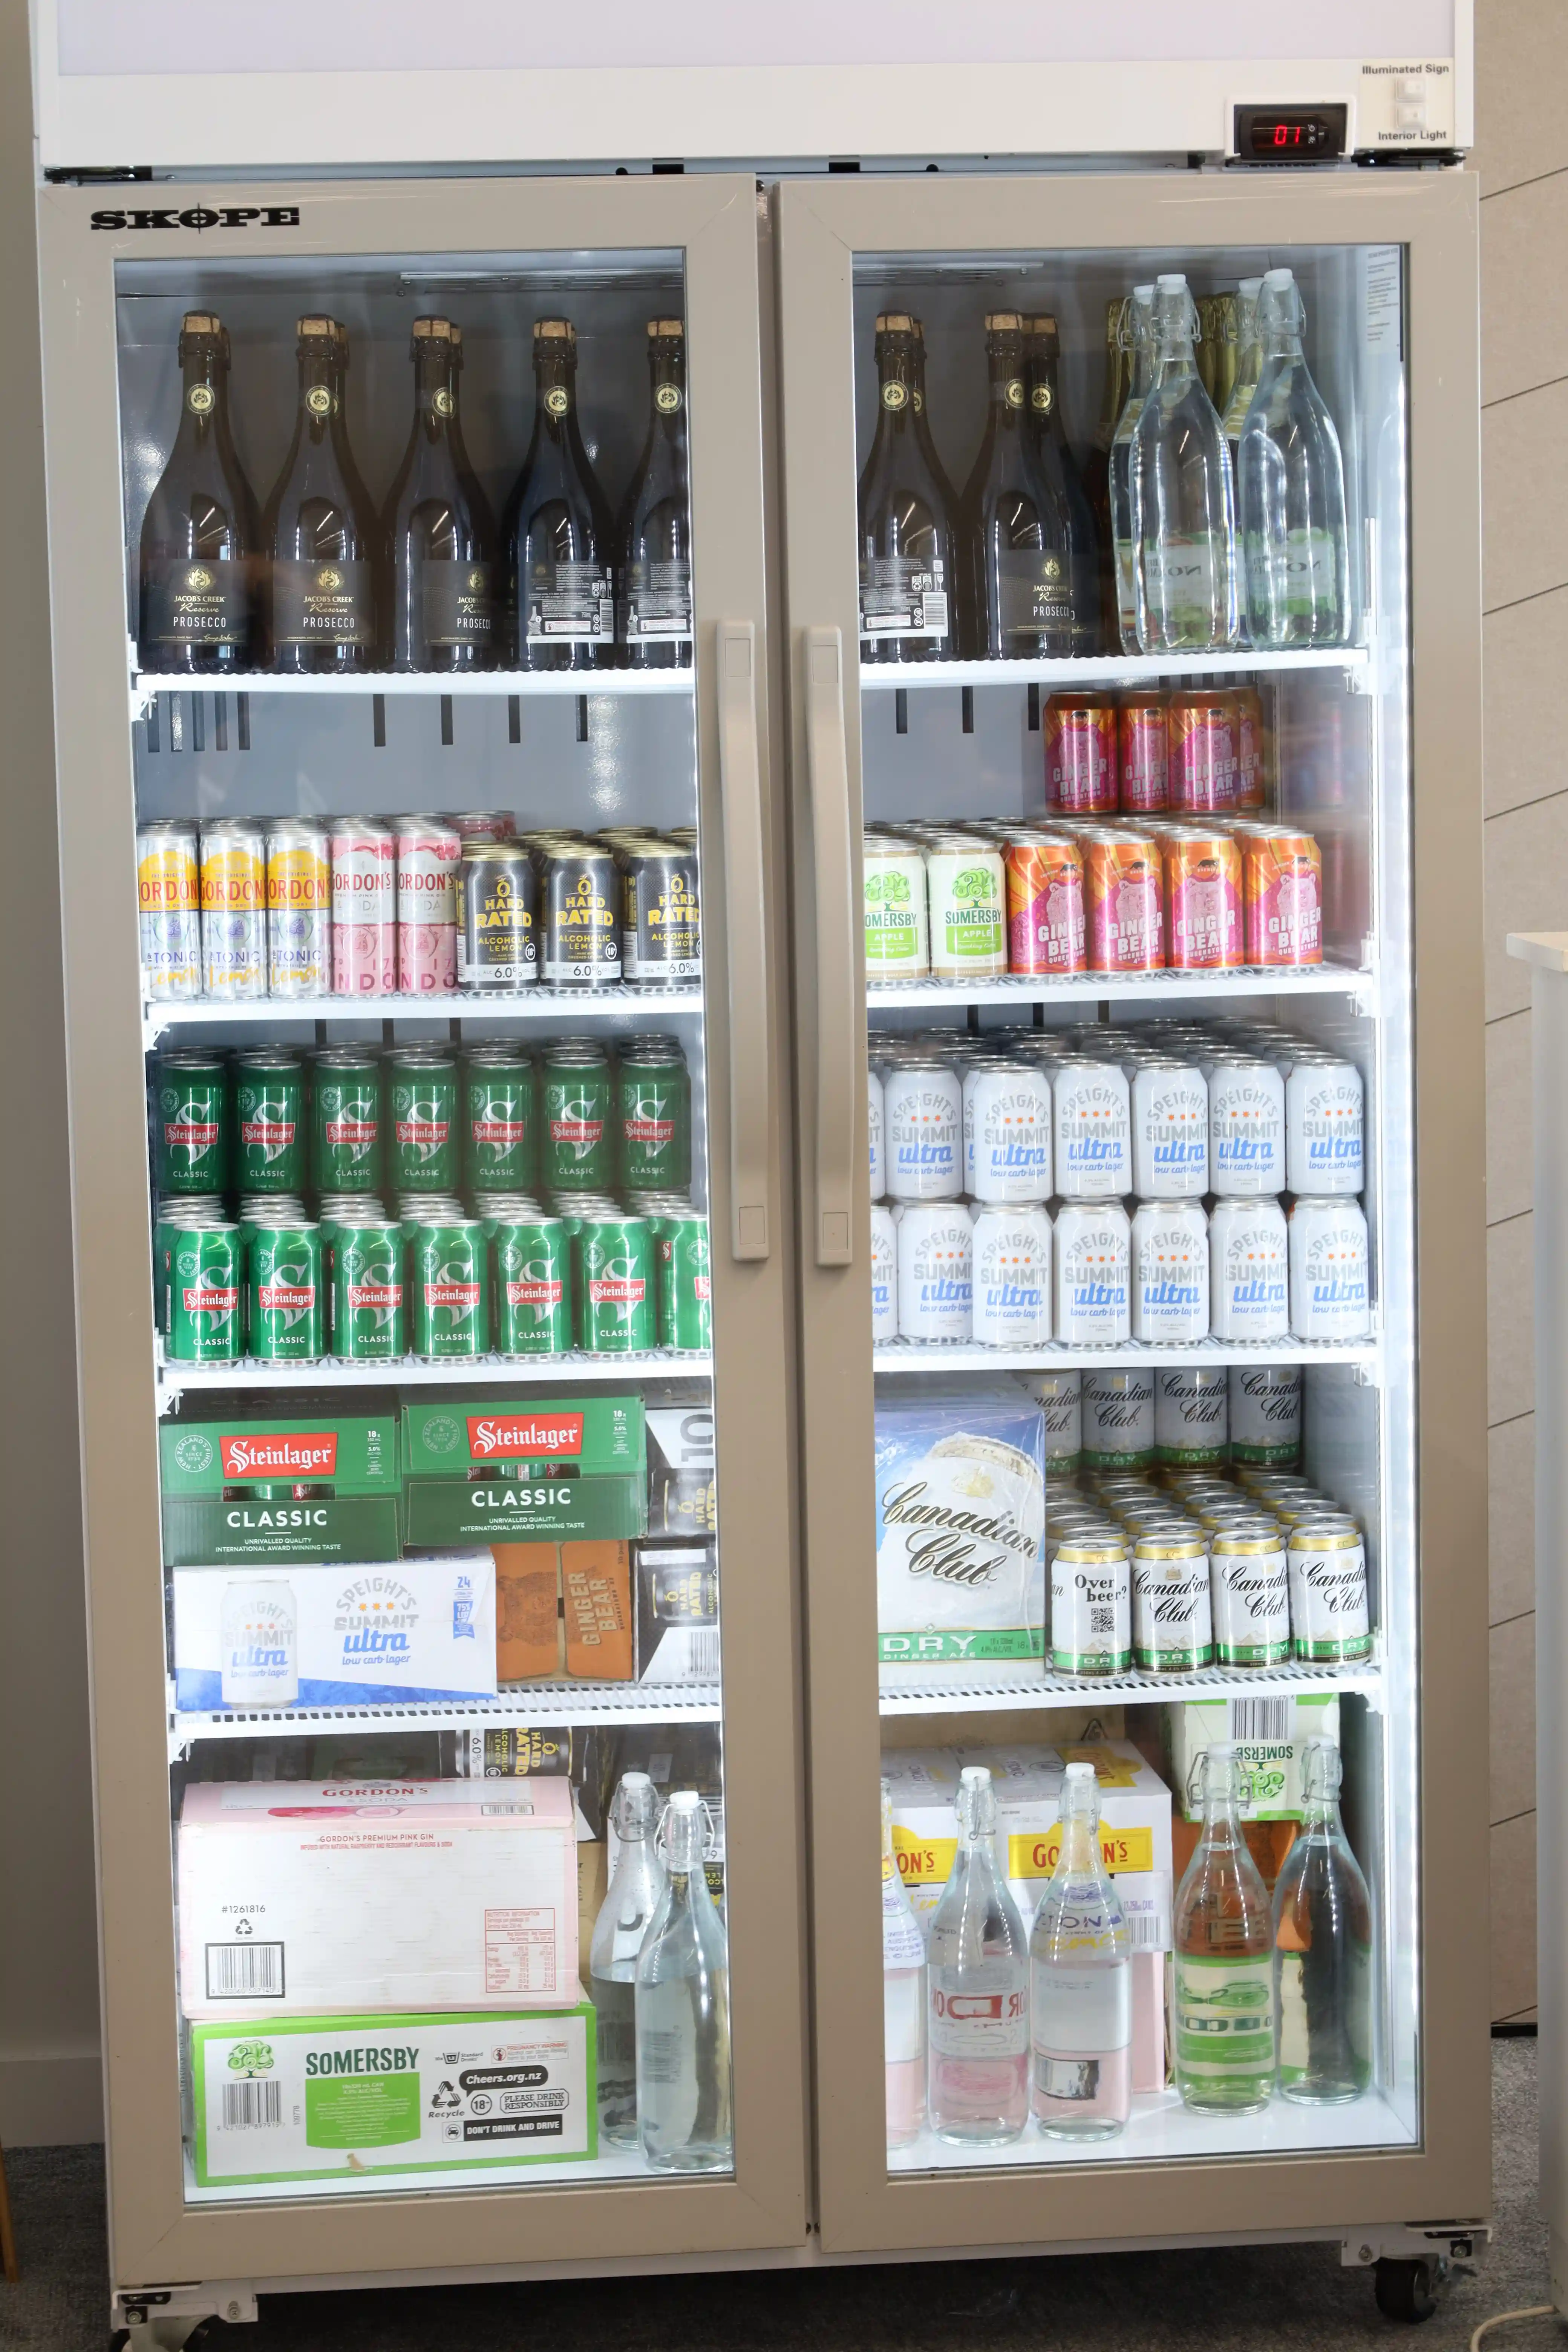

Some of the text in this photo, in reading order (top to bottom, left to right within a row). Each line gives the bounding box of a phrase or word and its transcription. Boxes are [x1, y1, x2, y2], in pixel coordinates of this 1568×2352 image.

[1362, 64, 1449, 76] Illuminated Sign
[1274, 125, 1300, 145] 01
[1378, 131, 1447, 142] Interior Light
[90, 203, 300, 234] SKOPE
[179, 603, 219, 613] Reserve
[309, 603, 348, 613] Reserve
[173, 616, 226, 628] PROSECCO
[303, 617, 355, 628] PROSECCO
[1053, 758, 1107, 782] GINGER
[1060, 775, 1101, 795] BEAR
[485, 898, 524, 910] HARD
[565, 897, 605, 908] HARD
[659, 895, 695, 906] HARD
[475, 911, 532, 930] RATED
[555, 910, 614, 927] RATED
[648, 908, 700, 926] RATED
[945, 909, 1001, 924] SOMERSBY
[1109, 911, 1163, 940] GINGER
[1269, 906, 1321, 934] GINGER
[478, 935, 530, 945] ALCOHOLIC
[489, 943, 522, 952] LEMON
[1118, 931, 1159, 955] BEAR
[216, 951, 260, 963] TONIC
[277, 950, 321, 961] TONIC
[495, 967, 522, 978] 6.0%
[573, 965, 602, 976] 6.0%
[668, 963, 695, 974] 6.0%
[893, 1093, 957, 1122] SPEIGHT'S
[985, 1095, 1049, 1124] SPEIGHT'S
[1062, 1087, 1125, 1118] SPEIGHT'S
[167, 1124, 216, 1141] Steinlager
[330, 1123, 377, 1141] Steinlager
[625, 1122, 672, 1139] Steinlager
[892, 1124, 957, 1142] SUMMIT
[985, 1125, 1050, 1145] SUMMIT
[1061, 1121, 1127, 1139] SUMMIT
[898, 1143, 954, 1164] ultra
[991, 1144, 1046, 1166] ultra
[1067, 1138, 1123, 1160] ultra
[630, 1166, 665, 1174] CLASSIC
[991, 1168, 1046, 1178] low carb lager
[982, 1233, 1047, 1263] SPEIGHT'S
[980, 1267, 1048, 1285] SUMMIT
[185, 1291, 237, 1309] Steinlager
[351, 1289, 401, 1306] Steinlager
[511, 1285, 561, 1302] Steinlager
[593, 1283, 644, 1300] Steinlager
[986, 1283, 1043, 1307] ultra
[193, 1338, 230, 1346] CLASSIC
[358, 1335, 395, 1343] CLASSIC
[1083, 1377, 1153, 1402] Canadian
[1095, 1403, 1139, 1427] Club
[1180, 1399, 1222, 1423] Club
[474, 1421, 578, 1453] Steinlager
[177, 1437, 211, 1470] NEW ZEALAND'S FINEST
[227, 1441, 332, 1473] Steinlager
[1184, 1450, 1220, 1458] DRY
[471, 1488, 571, 1507] CLASSIC
[695, 1488, 706, 1524] HARD
[227, 1510, 328, 1528] CLASSIC
[882, 1481, 1038, 1559] Canadian
[618, 1556, 623, 1564] 10
[905, 1528, 1007, 1585] Club
[457, 1577, 471, 1588] 24
[1075, 1574, 1115, 1589] Over
[1133, 1568, 1209, 1596] Canadian
[335, 1577, 417, 1613] SPEIGHT'S
[689, 1572, 703, 1616] RATED
[1086, 1587, 1127, 1602] beer?
[1323, 1588, 1363, 1613] Club
[568, 1571, 601, 1645] GINGER
[588, 1579, 617, 1631] BEAR
[1150, 1597, 1196, 1623] Club
[1245, 1592, 1285, 1618] Club
[334, 1614, 419, 1631] SUMMIT
[343, 1628, 411, 1653] ultra
[883, 1635, 977, 1652] DRY
[1252, 1644, 1288, 1655] DRY
[1331, 1640, 1366, 1651] DRY
[342, 1654, 411, 1666] low carb lager
[472, 1738, 482, 1764] 6.0%
[531, 1732, 541, 1767] HARD
[322, 1786, 430, 1797] GORDON'S
[222, 1905, 266, 1913] #1261816
[306, 2047, 420, 2076] SOMERSBY
[466, 2072, 542, 2084] Cheers.org.nz
[473, 2100, 489, 2110] 18+
[504, 2094, 534, 2102] PLEASE
[504, 2100, 565, 2110] RESPONSIBLY
[428, 2110, 465, 2118] Recycle
[467, 2125, 490, 2135] DON'T
[492, 2124, 516, 2133] DRINK
[537, 2121, 559, 2130] DRIVE
